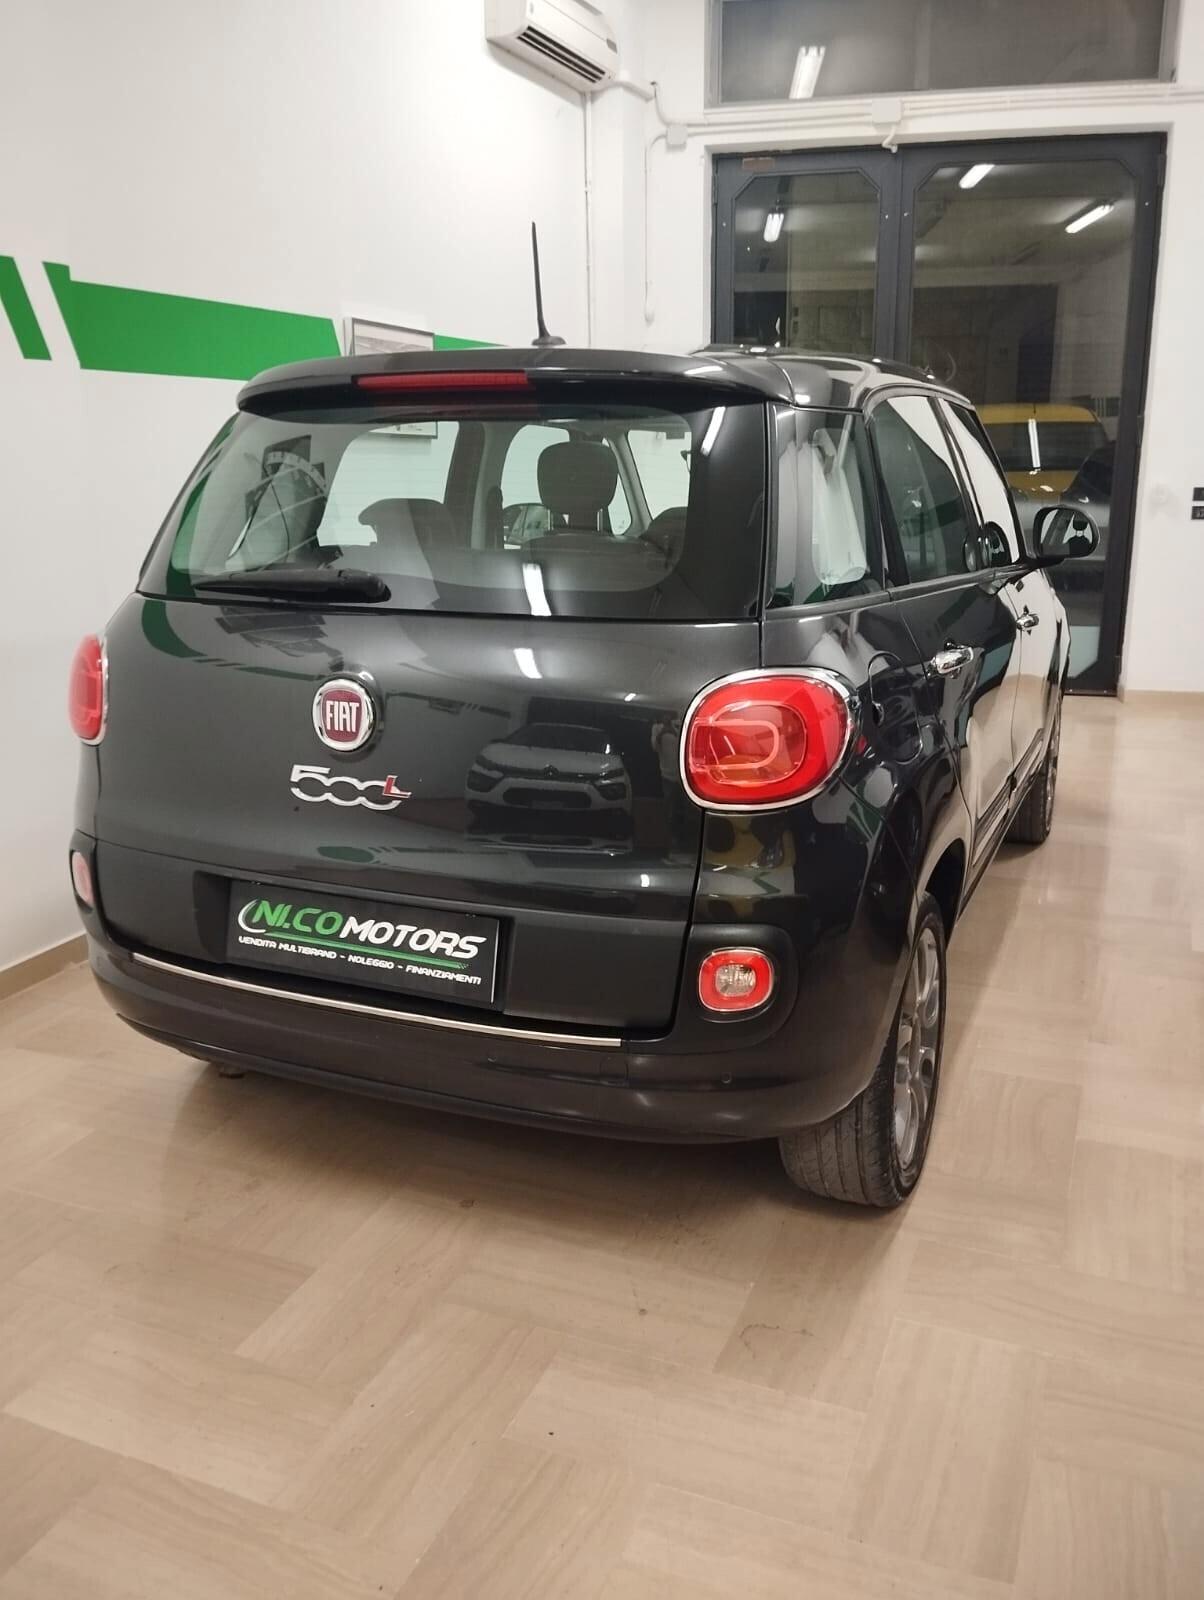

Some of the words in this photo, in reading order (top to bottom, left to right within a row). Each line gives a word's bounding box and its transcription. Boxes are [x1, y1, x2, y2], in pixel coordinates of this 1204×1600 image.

[325, 700, 360, 733] FIAT
[238, 936, 277, 949] VENDITA
[278, 943, 338, 959] MULTIBRAND
[348, 954, 395, 970] NOLEGGIO
[405, 965, 482, 985] FINANZIAMENTI
